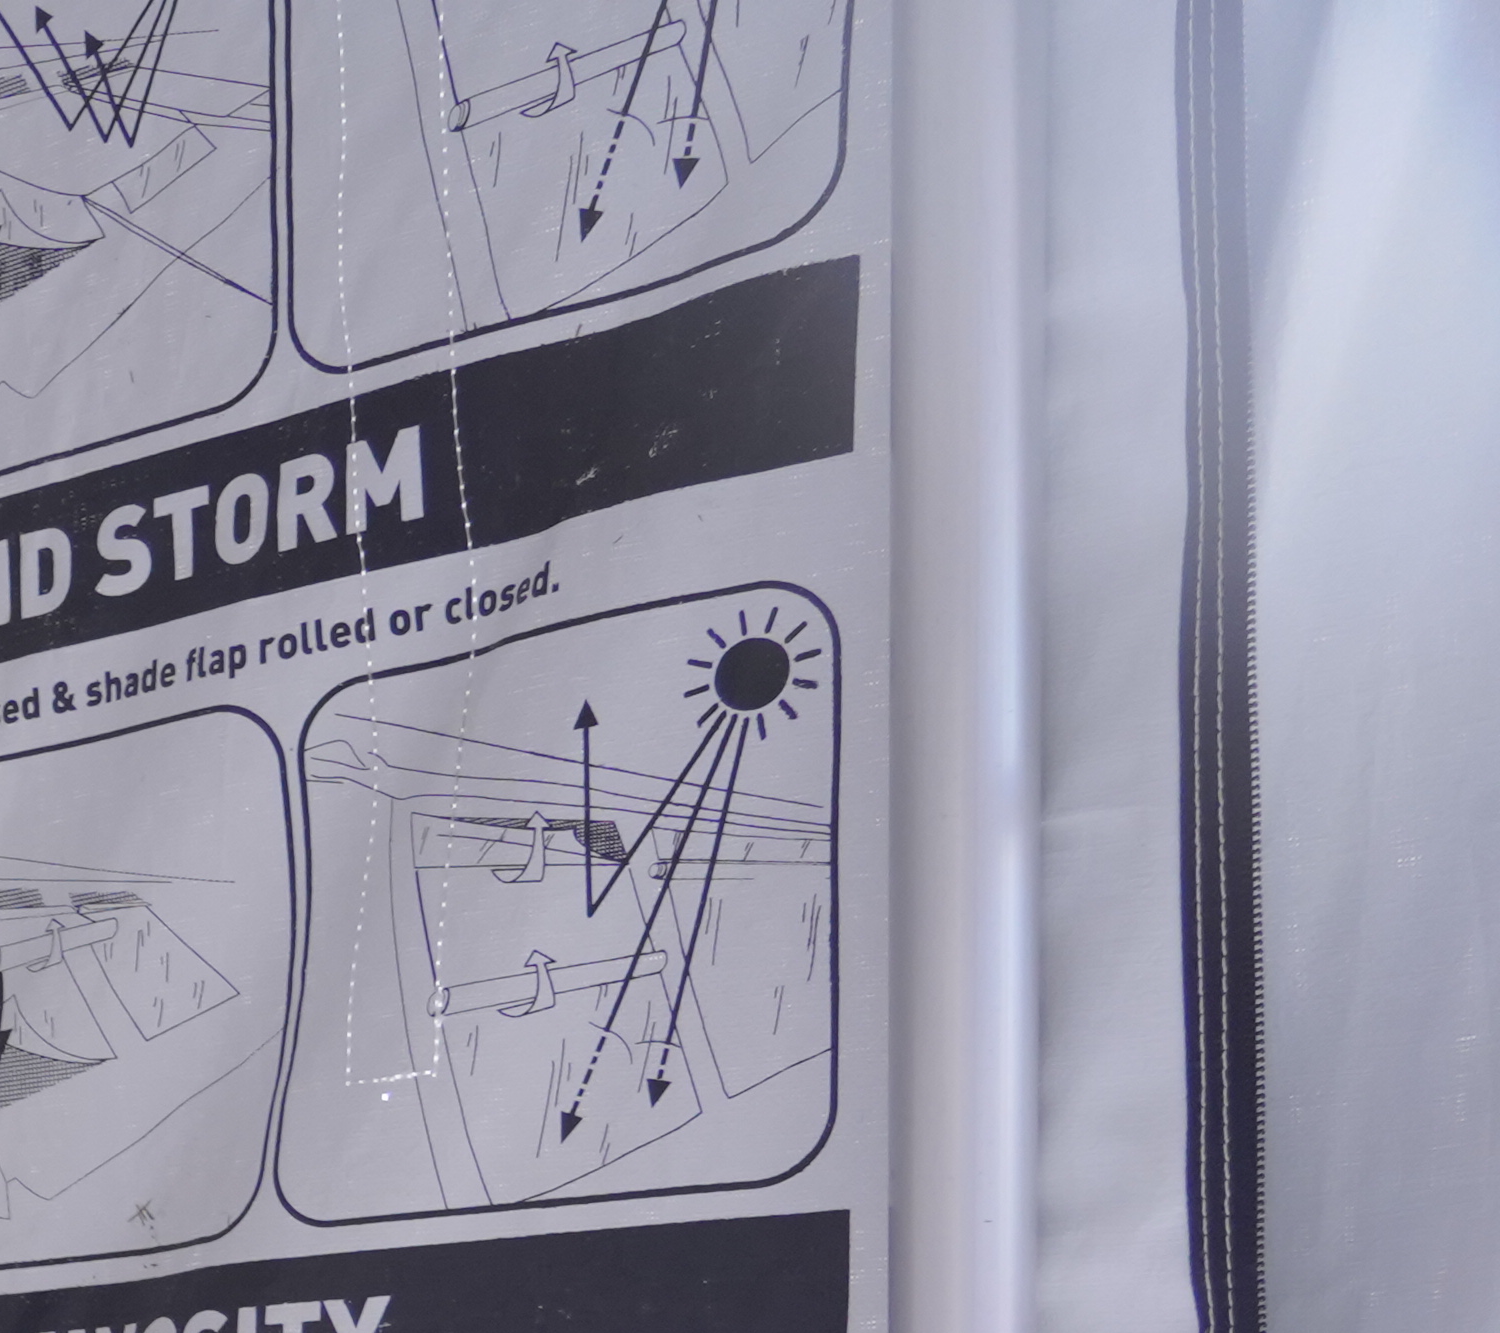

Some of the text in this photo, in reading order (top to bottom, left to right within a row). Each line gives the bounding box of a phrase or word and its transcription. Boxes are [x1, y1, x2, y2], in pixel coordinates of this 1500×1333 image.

[95, 425, 426, 599] STORM
[51, 680, 77, 713] &
[85, 658, 177, 707] shade
[186, 642, 248, 682] flap
[259, 607, 377, 665] rolled
[388, 602, 434, 636] or
[444, 560, 561, 625] closed.
